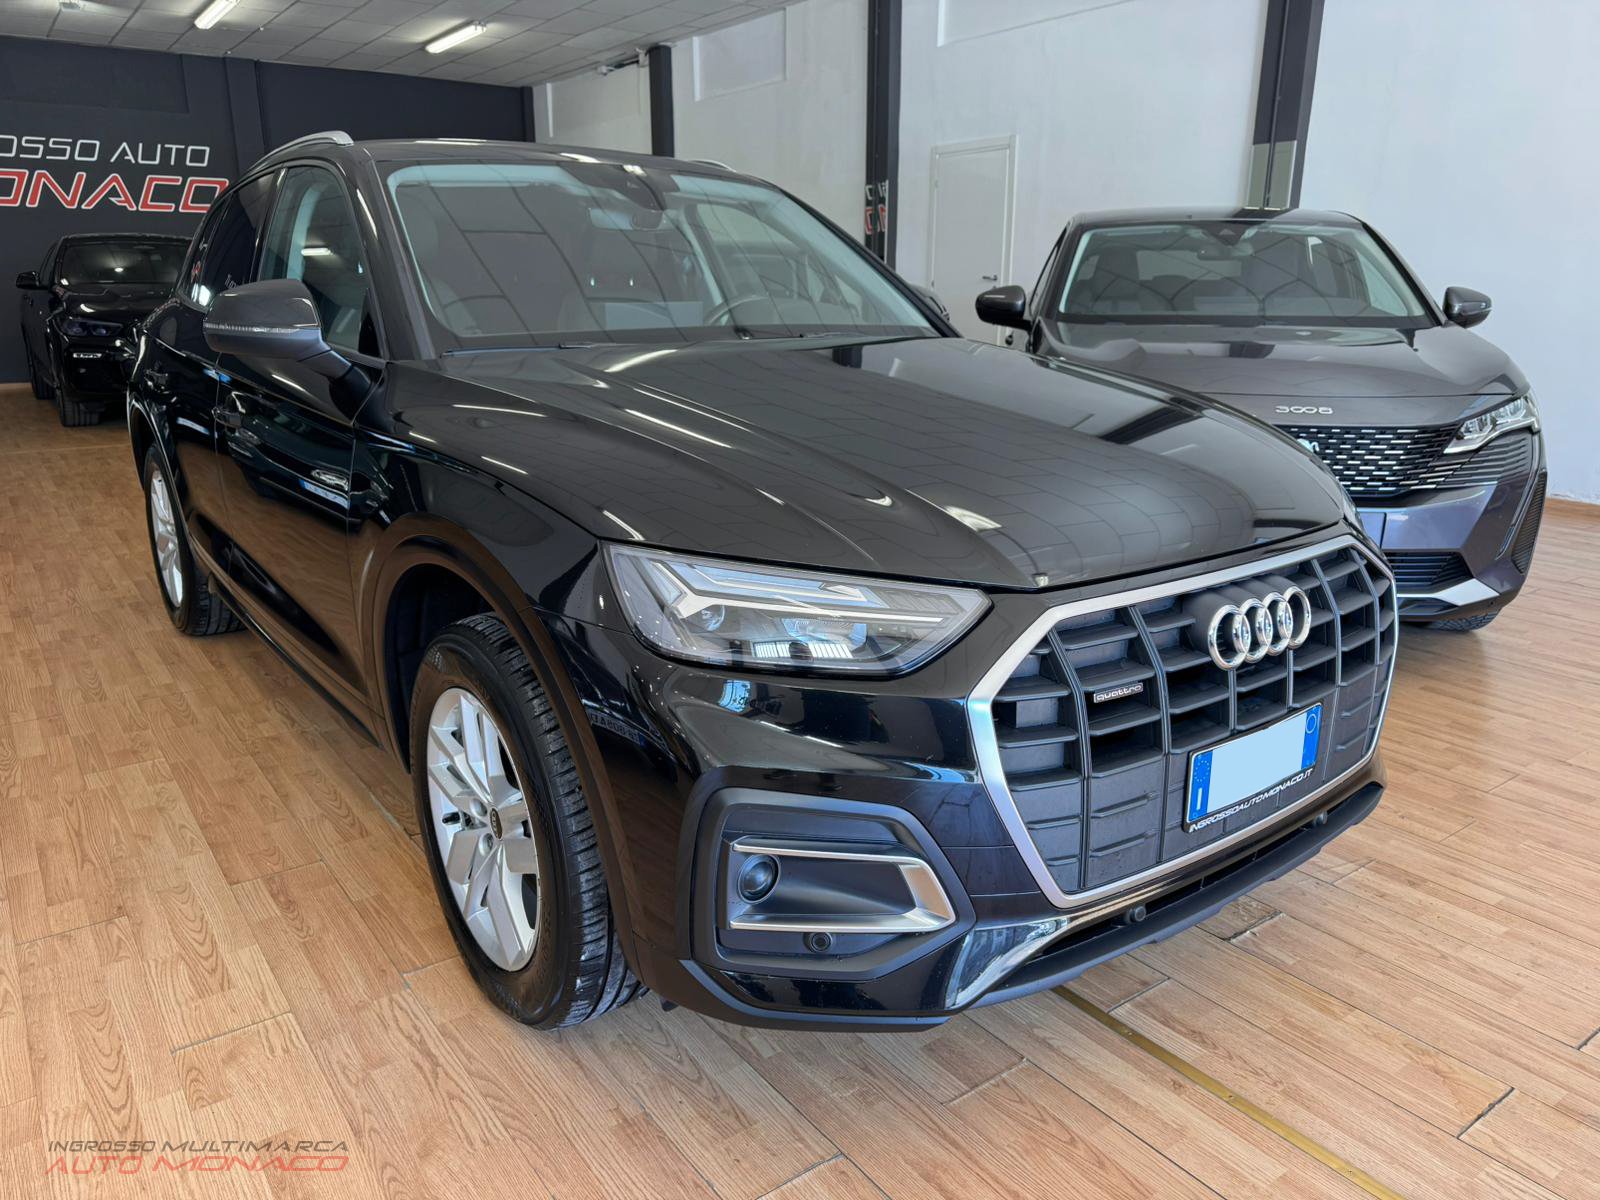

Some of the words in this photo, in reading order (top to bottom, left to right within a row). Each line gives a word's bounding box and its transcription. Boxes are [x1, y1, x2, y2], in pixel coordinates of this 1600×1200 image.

[110, 142, 210, 167] AUTO
[1275, 405, 1333, 414] 3008
[1096, 684, 1142, 701] quattro
